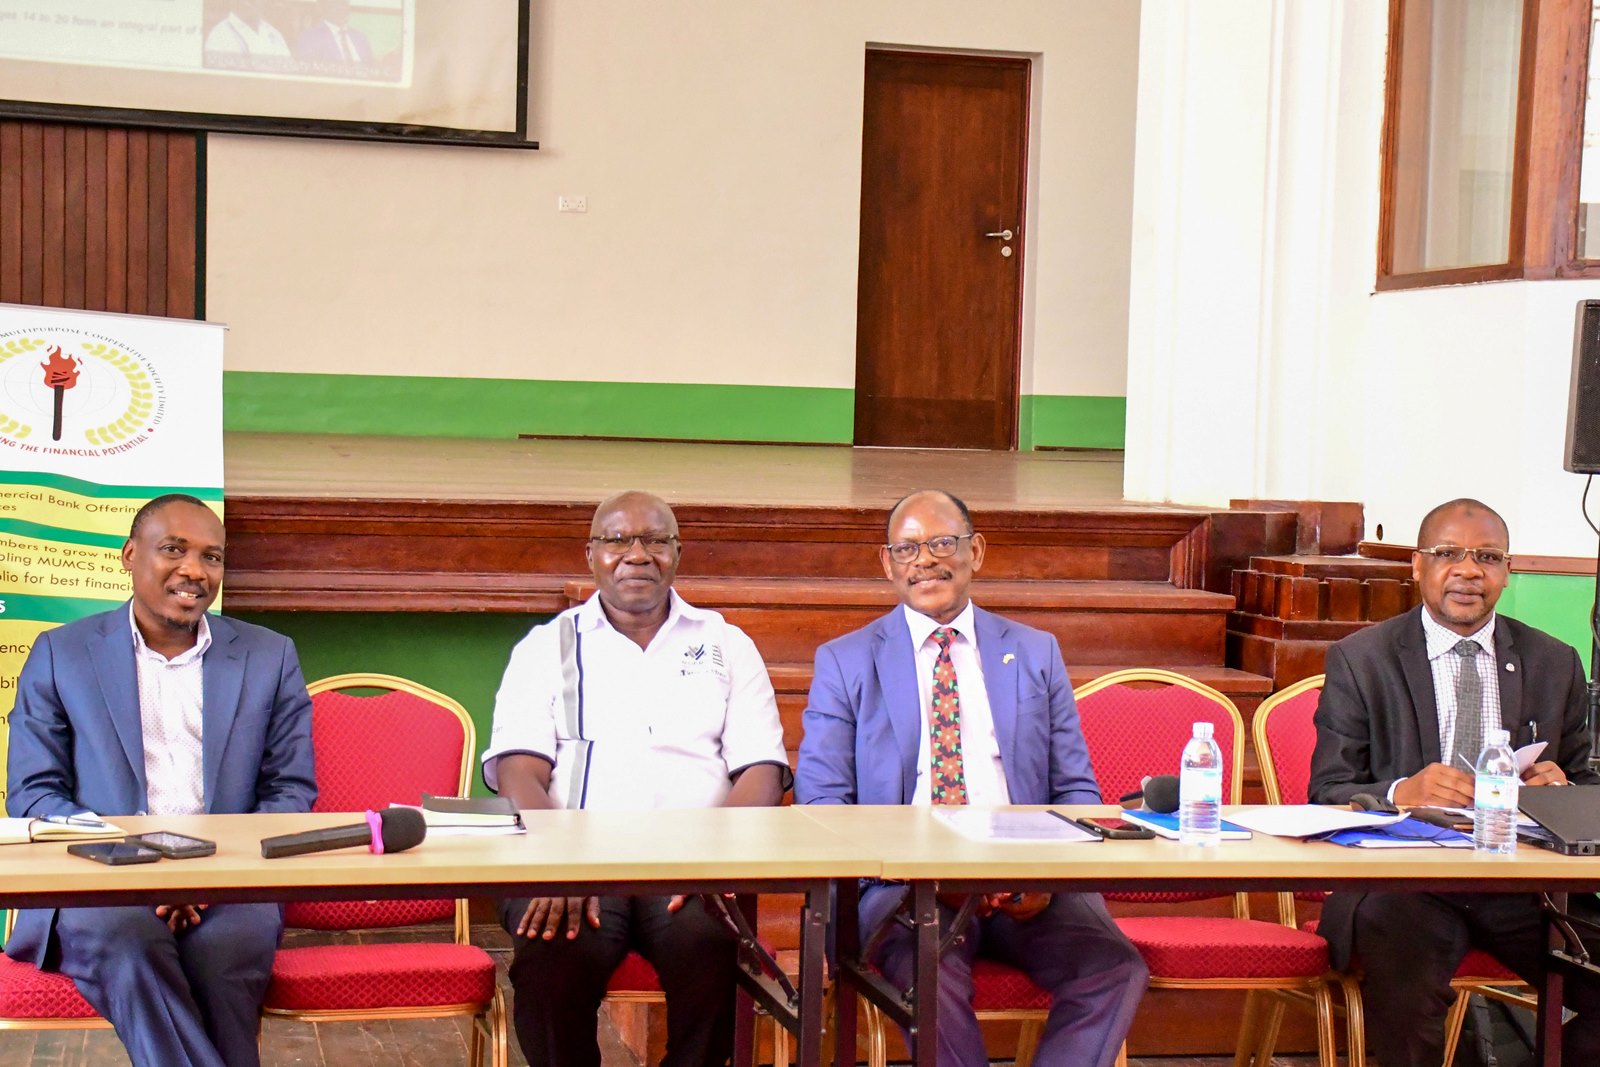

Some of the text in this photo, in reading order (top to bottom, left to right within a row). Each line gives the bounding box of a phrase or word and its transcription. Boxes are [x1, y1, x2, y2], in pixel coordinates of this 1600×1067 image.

[20, 443, 39, 453] THE
[43, 447, 101, 457] FINANCIAL
[102, 434, 149, 456] POTENTIAL
[48, 494, 80, 510] Bank
[63, 549, 98, 557] grow
[37, 557, 95, 571] MUMCS
[101, 565, 114, 573] to
[0, 570, 18, 582] lio
[24, 571, 44, 584] for
[50, 573, 80, 587] best
